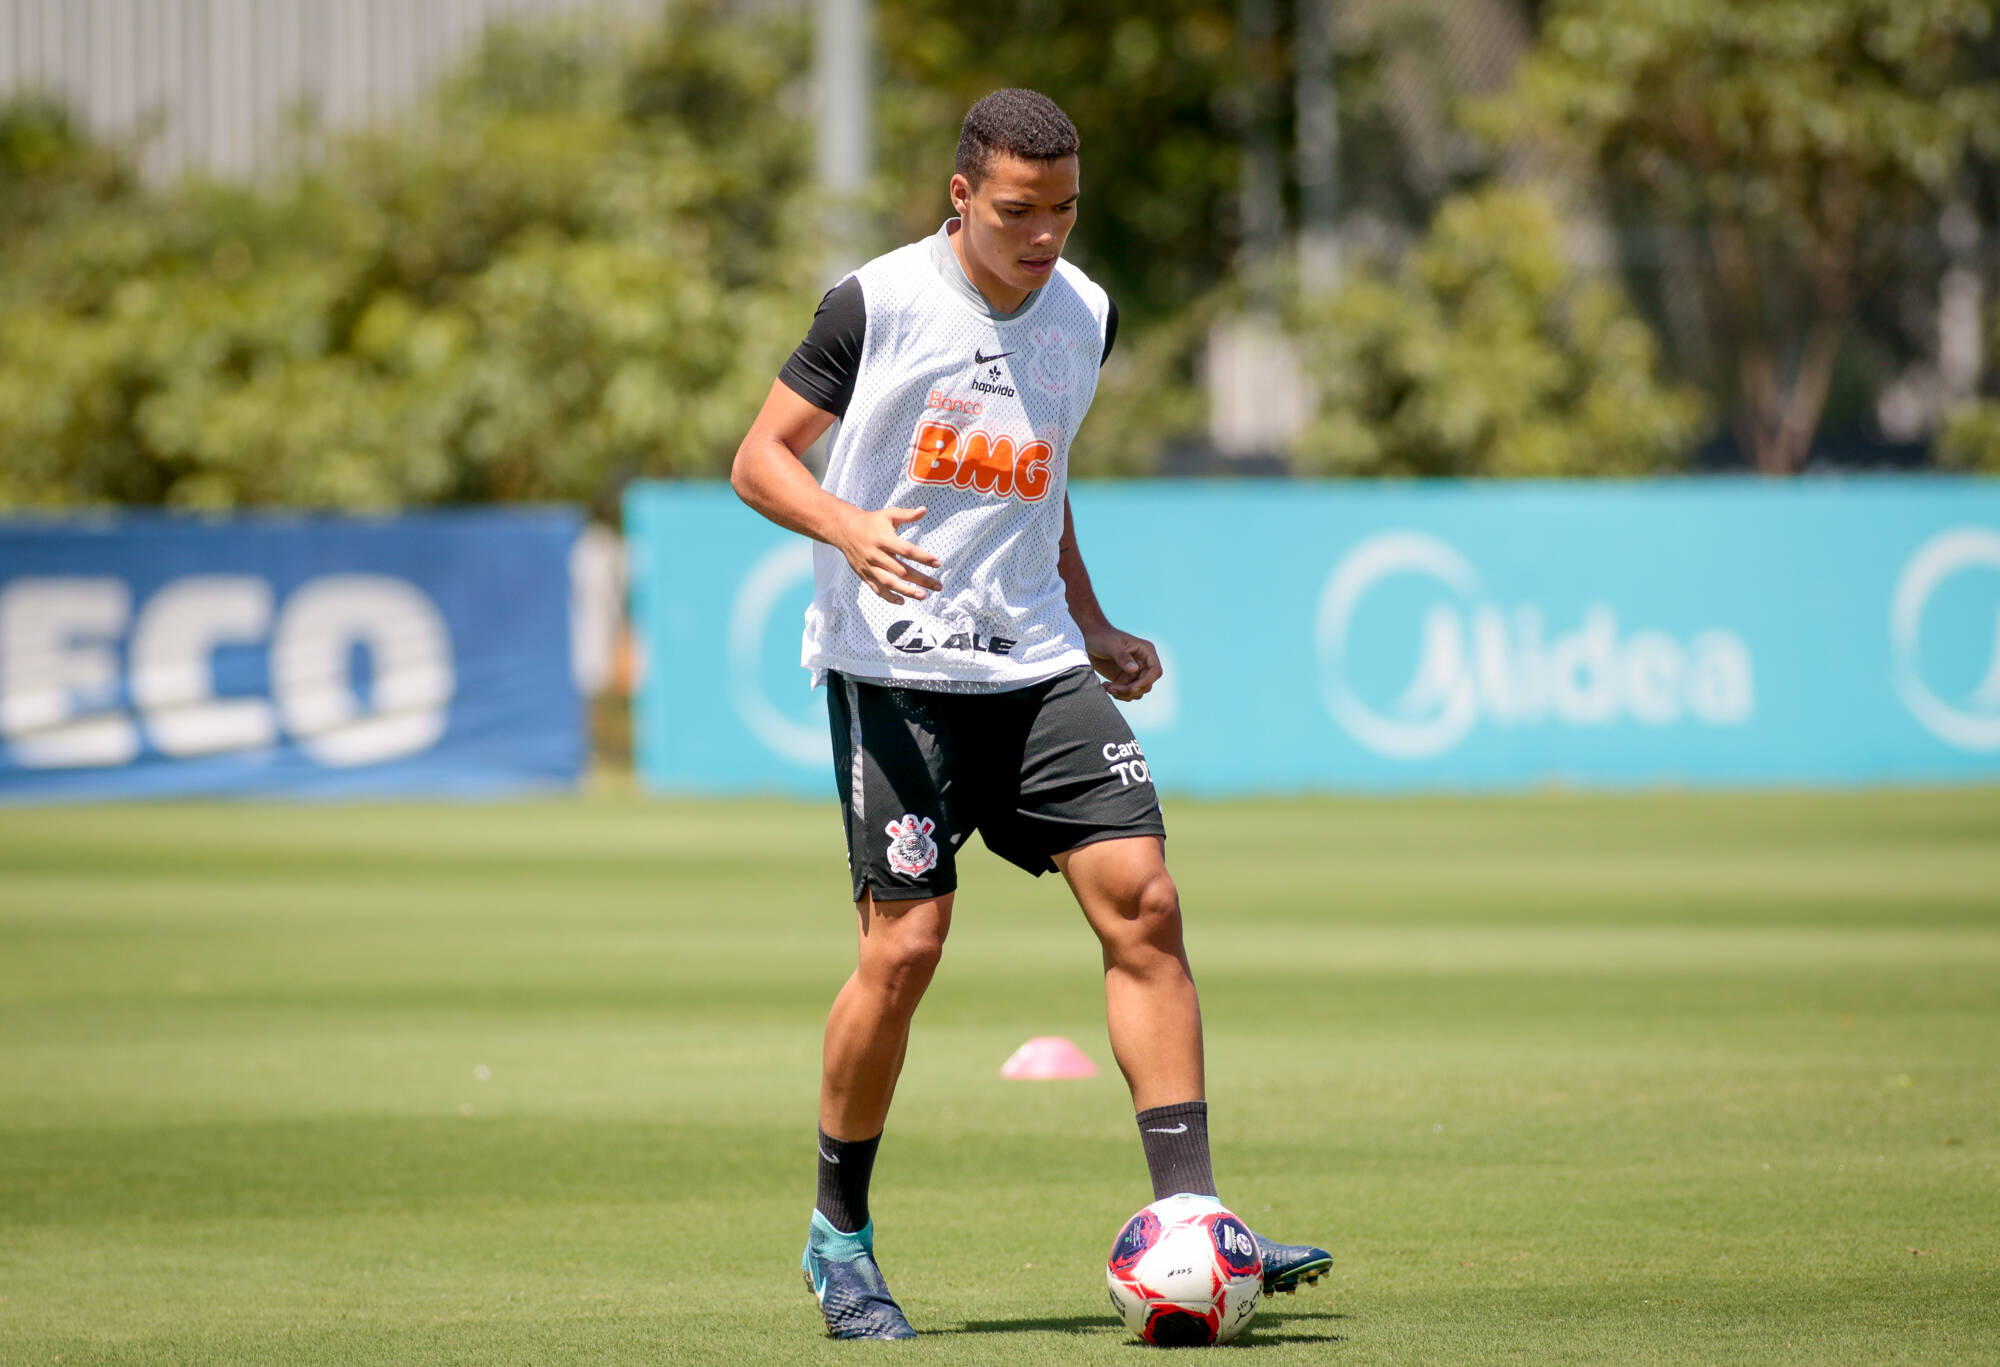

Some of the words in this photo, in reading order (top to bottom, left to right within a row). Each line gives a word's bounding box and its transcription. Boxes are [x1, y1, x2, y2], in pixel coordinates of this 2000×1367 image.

[928, 390, 983, 415] Banco
[971, 379, 1015, 397] hapvida
[908, 420, 1054, 502] BMG
[0, 574, 455, 768] ECO
[1388, 600, 1750, 752] Midea
